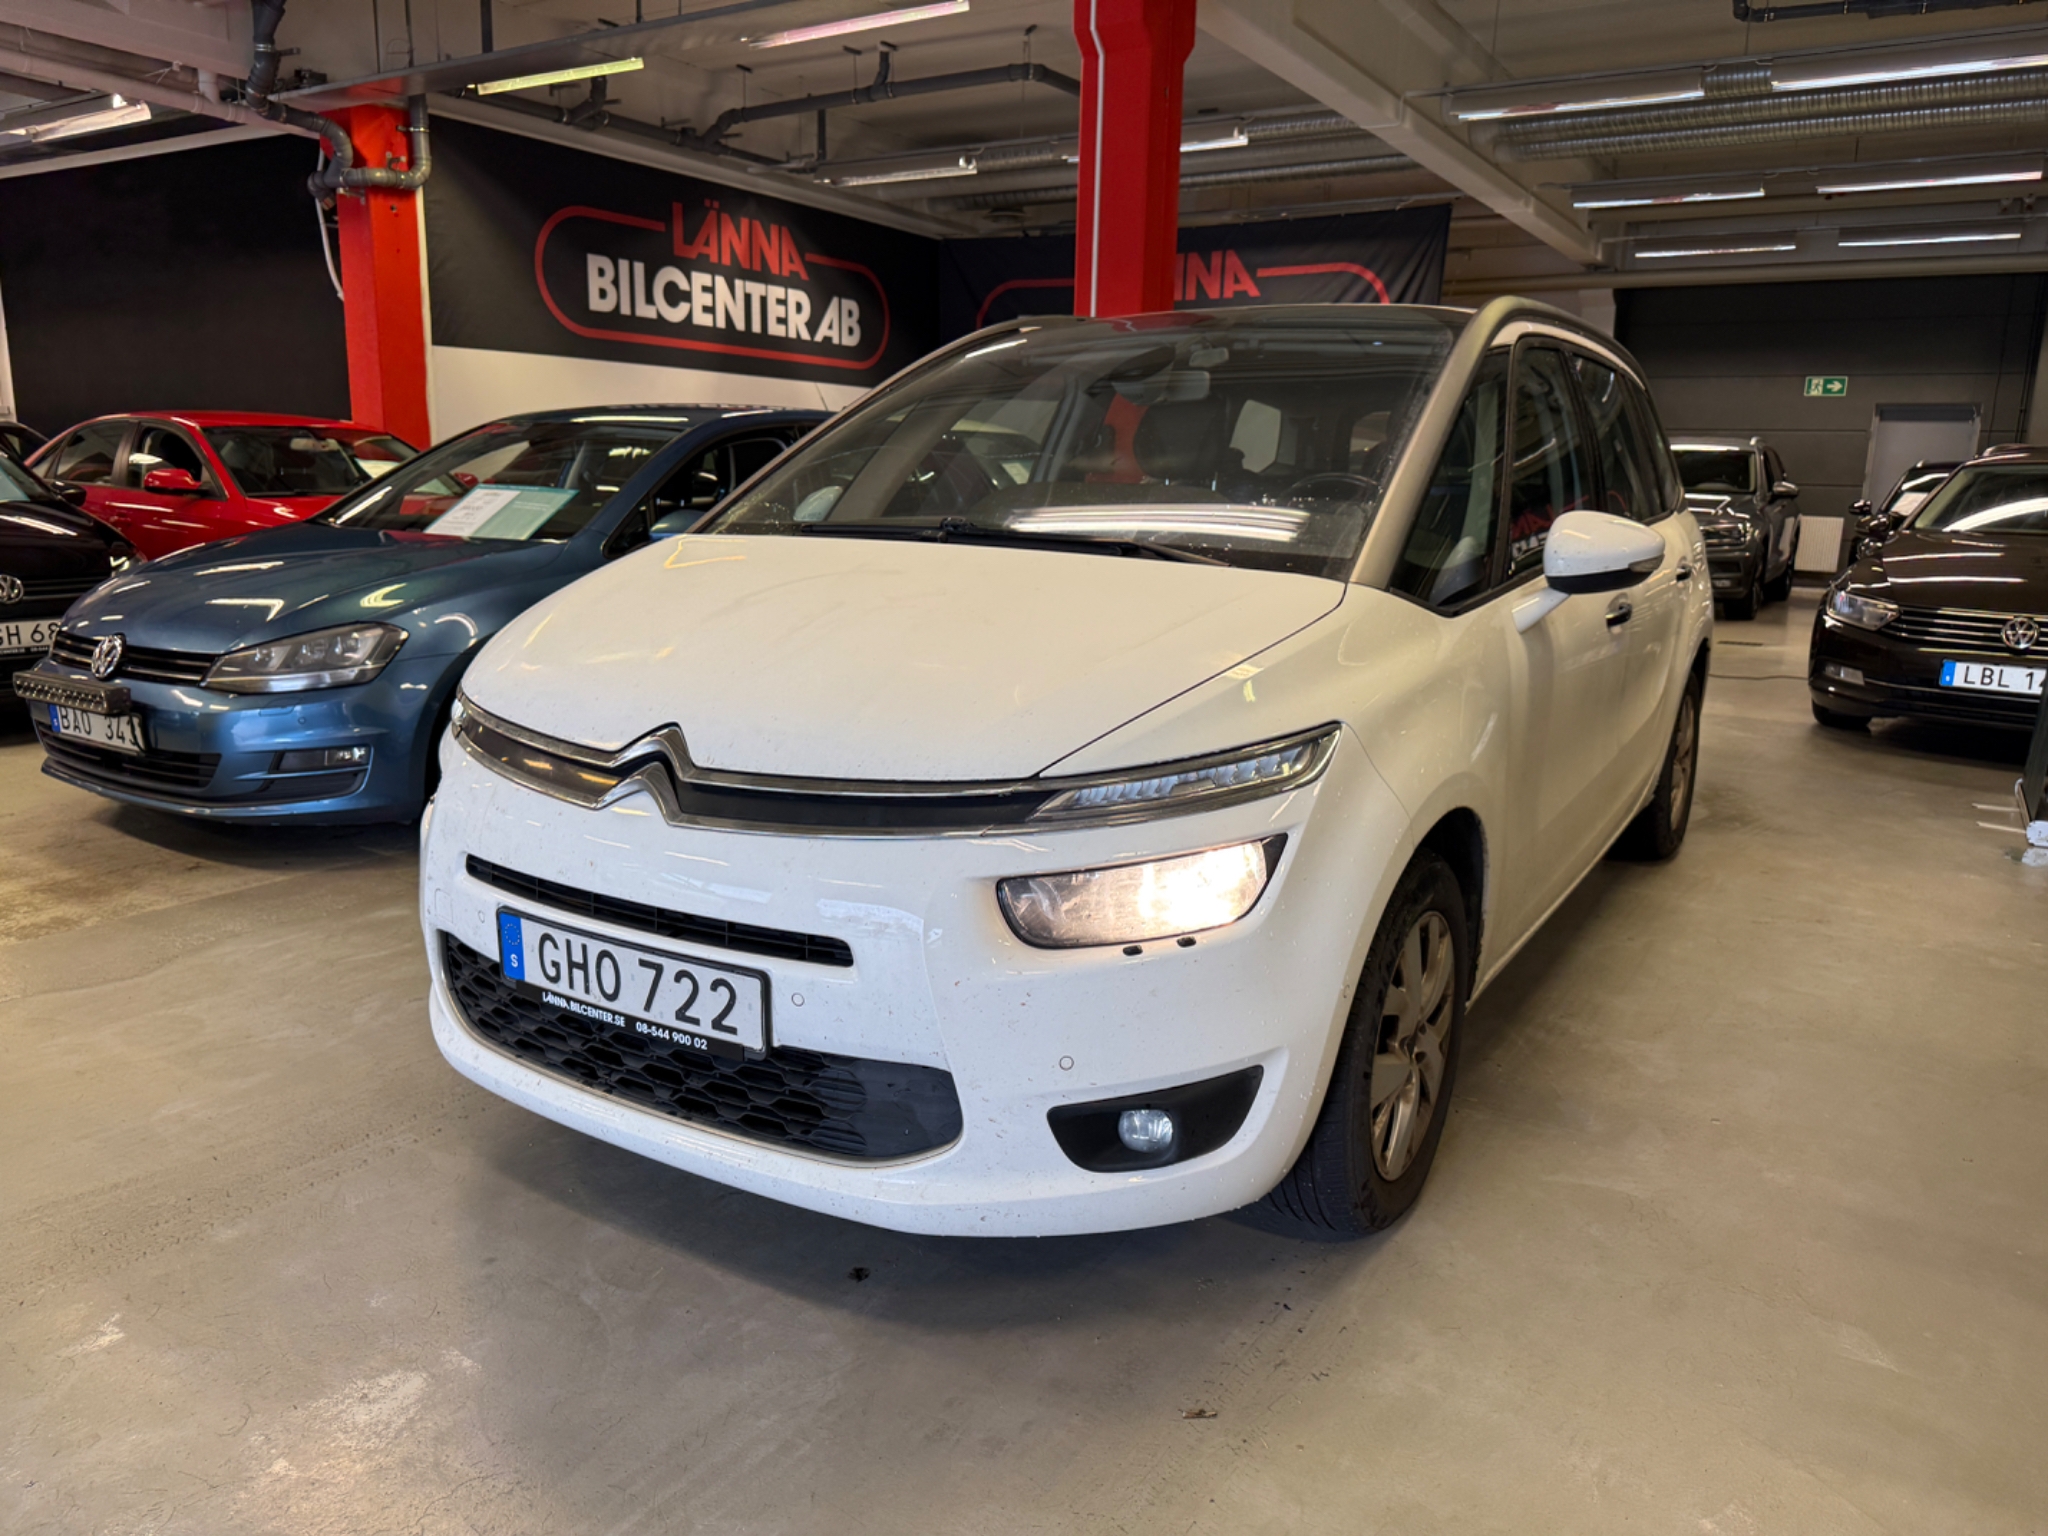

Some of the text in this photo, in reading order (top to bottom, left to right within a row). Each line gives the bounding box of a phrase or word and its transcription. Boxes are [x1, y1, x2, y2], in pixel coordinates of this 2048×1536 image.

[672, 198, 810, 281] LÄNNA
[586, 253, 862, 348] BILCENTER AB
[0, 622, 21, 646] H
[1963, 665, 2010, 688] LBL
[538, 931, 738, 1036] GHO 722
[570, 1000, 626, 1028] BILCENTER.SE
[635, 1021, 708, 1051] 08-544 900 02
